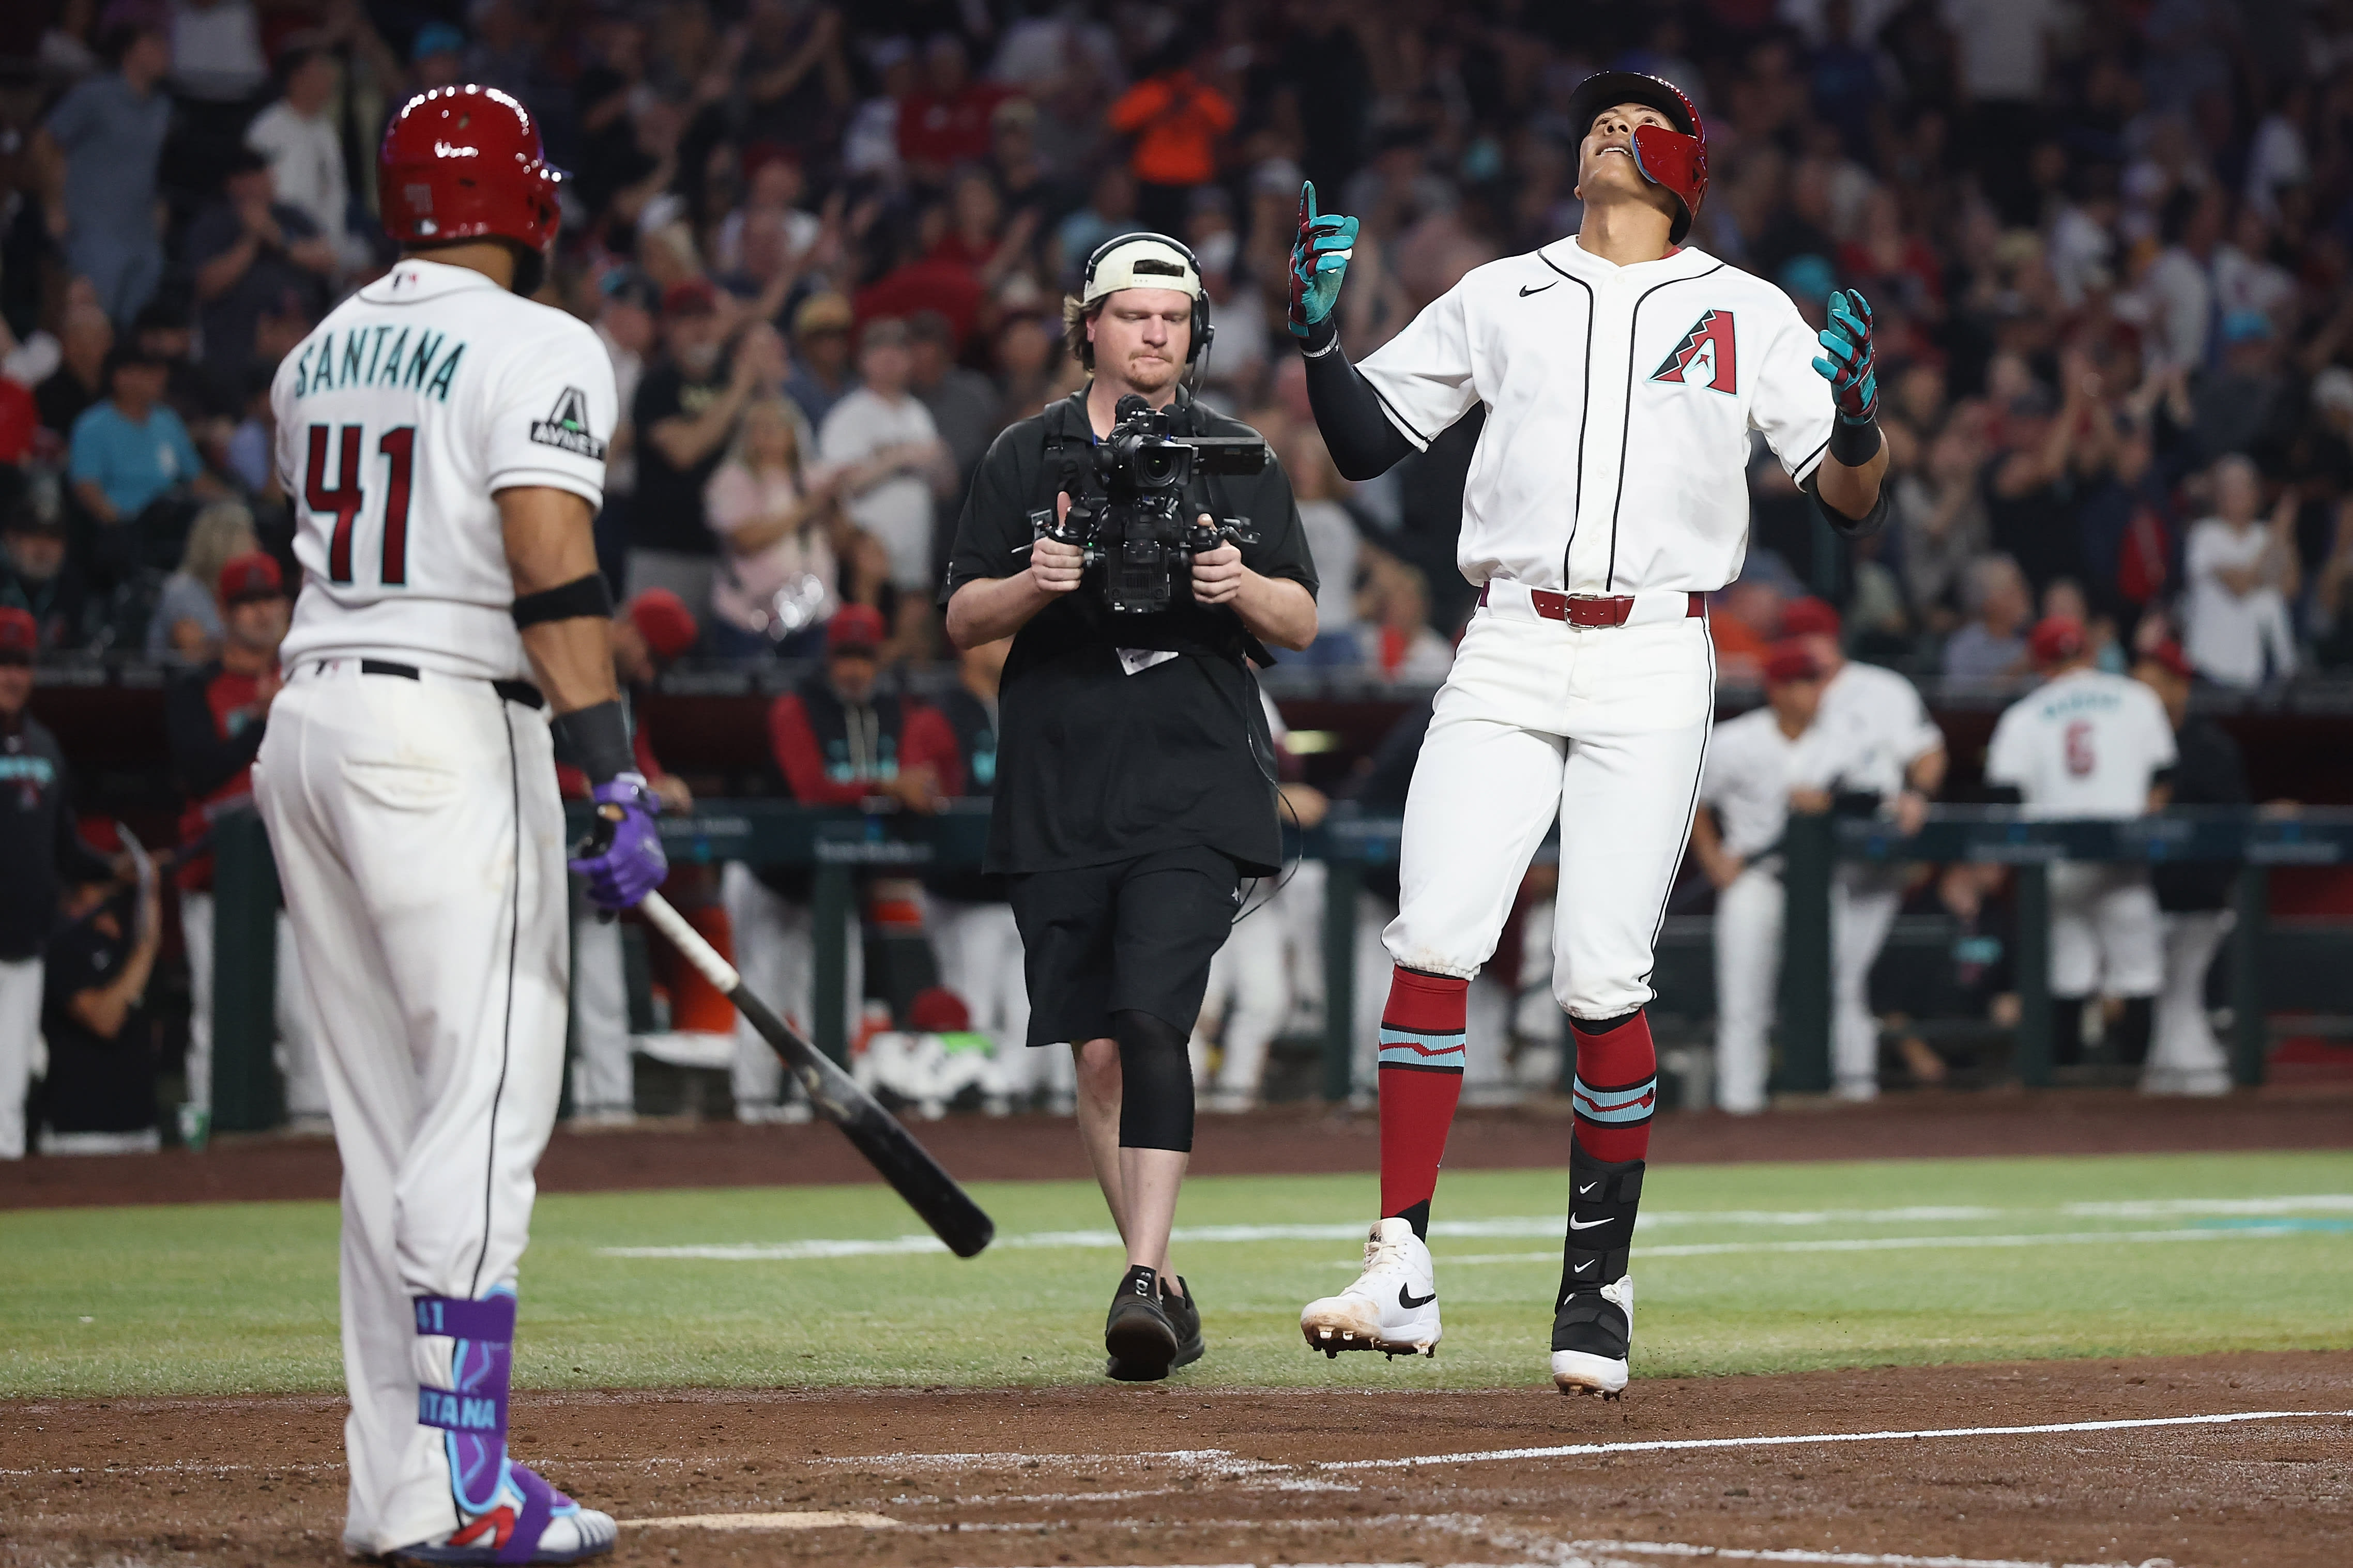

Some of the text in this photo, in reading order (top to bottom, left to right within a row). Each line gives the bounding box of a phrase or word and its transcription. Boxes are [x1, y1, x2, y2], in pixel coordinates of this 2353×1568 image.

[295, 326, 466, 403] SANTANA
[532, 422, 601, 457] AVNET
[305, 424, 417, 587] 41
